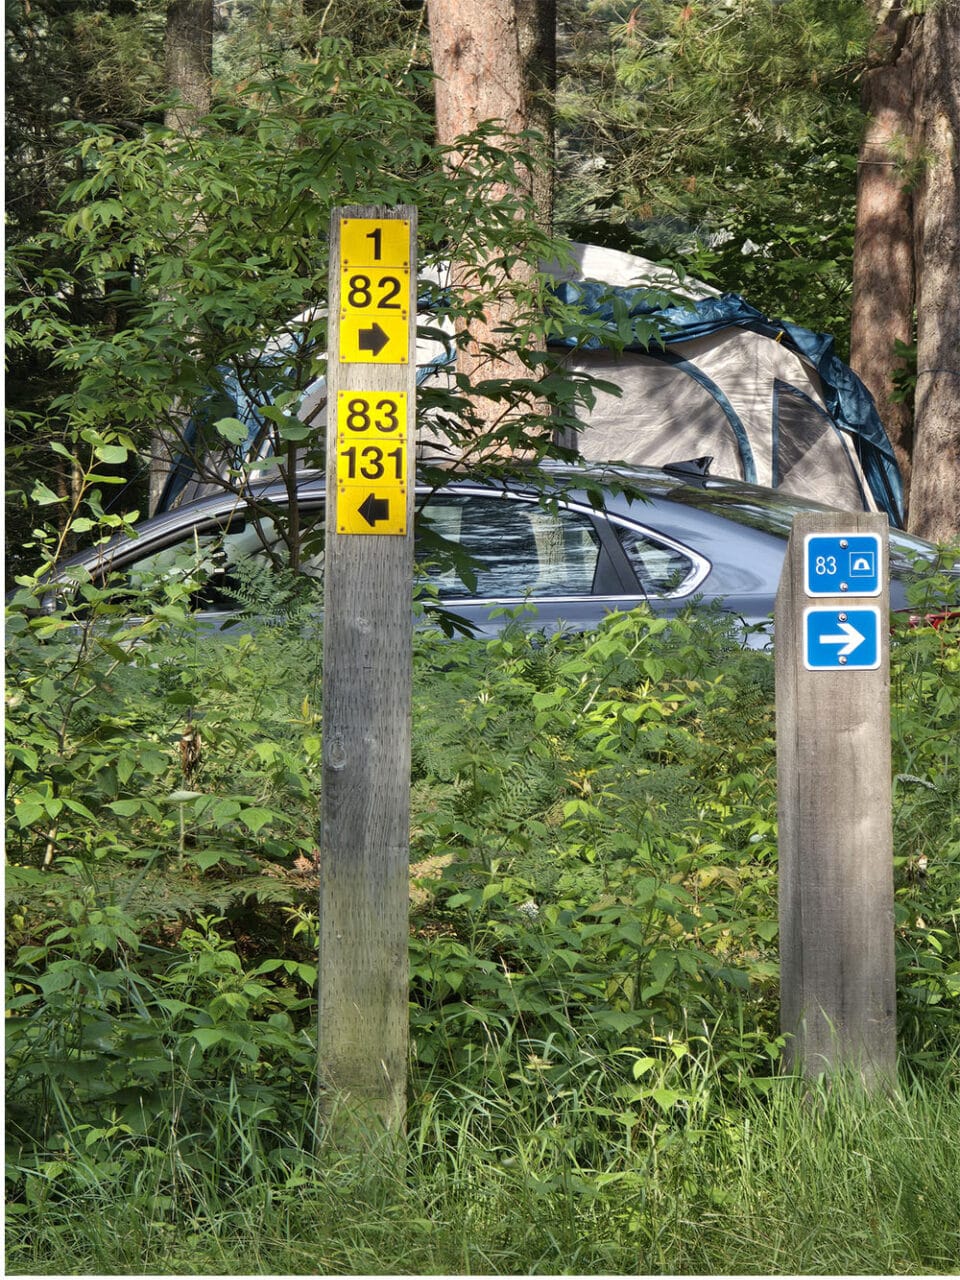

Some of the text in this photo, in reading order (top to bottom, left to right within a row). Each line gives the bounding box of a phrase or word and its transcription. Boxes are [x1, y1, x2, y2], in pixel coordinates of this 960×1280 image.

[366, 228, 381, 260] 1
[347, 275, 401, 309] 82
[346, 399, 399, 432] 83
[340, 446, 403, 479] 131
[815, 556, 837, 575] 83
